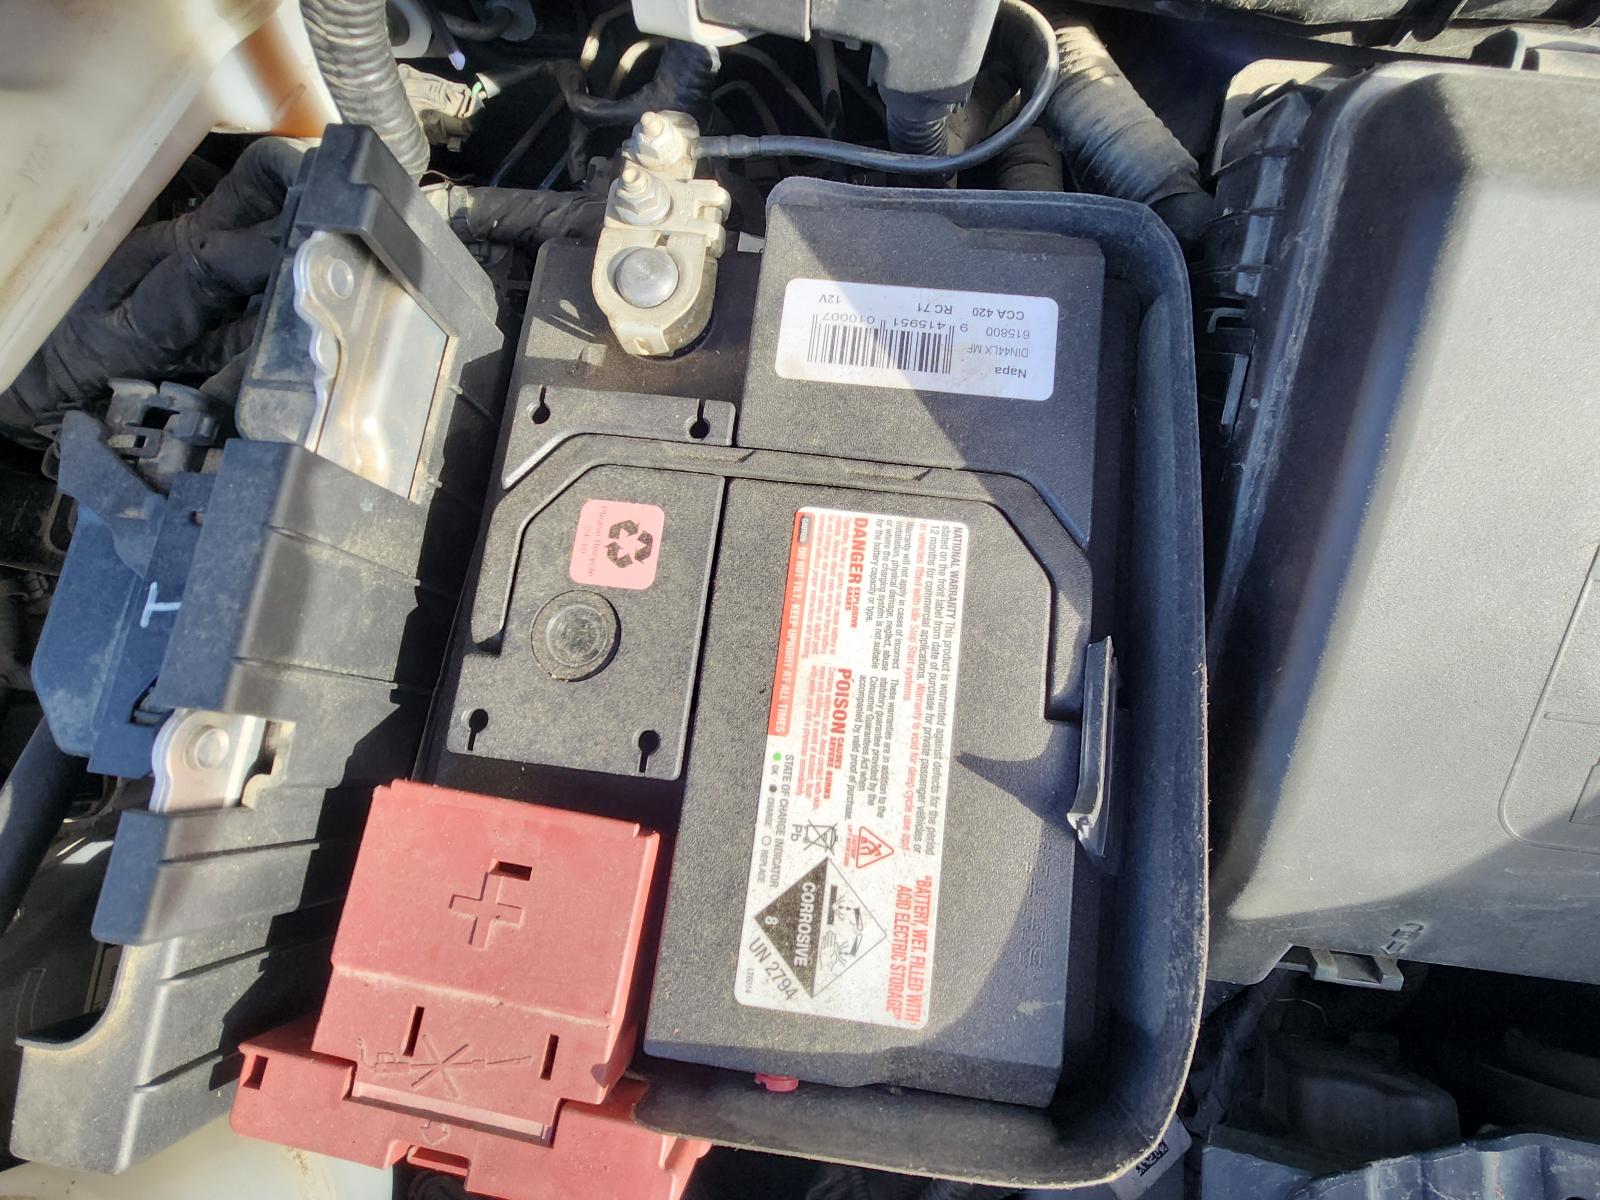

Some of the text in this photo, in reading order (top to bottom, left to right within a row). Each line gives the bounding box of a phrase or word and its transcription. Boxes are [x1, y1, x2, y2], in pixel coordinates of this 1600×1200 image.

[819, 294, 1024, 319] CCA 420 RC 71 12V
[823, 312, 967, 331] 9 415951 010007
[986, 327, 1029, 338] 615800
[967, 344, 1028, 357] DIN44LX MF
[994, 366, 1026, 378] Napa
[874, 529, 882, 540] the
[884, 529, 892, 548] where
[901, 521, 913, 551] Warranty
[930, 525, 938, 534] 12
[797, 547, 806, 559] DO
[848, 517, 867, 583] DANGER
[870, 542, 880, 564] battery
[882, 550, 890, 561] the
[902, 553, 910, 564] will
[927, 537, 937, 565] months
[950, 527, 962, 567] NATIONAL
[795, 561, 804, 576] NOT
[866, 566, 877, 594] capacity
[878, 563, 889, 592] charging
[926, 568, 935, 579] for
[790, 581, 802, 601] TILT,
[897, 579, 907, 597] apply
[946, 570, 958, 618] WARRANTY
[789, 604, 799, 625] KEEP
[850, 587, 860, 627] EXPLOSIVE
[875, 594, 885, 618] system
[921, 580, 934, 627] commercial
[944, 622, 954, 638] This
[783, 629, 796, 667] UPRIGHT
[871, 641, 881, 668] suitable
[892, 638, 901, 668] incorrect
[916, 629, 929, 680] applications.
[940, 640, 952, 671] product
[782, 671, 791, 680] AT
[780, 685, 789, 699] ALL
[831, 668, 851, 733] POISON
[912, 683, 924, 719] Warranty
[913, 526, 950, 853] stated on the front label from date of purchase for private passenger vehicles or
[936, 683, 948, 725] warranted
[775, 703, 787, 732] TIMES
[858, 676, 877, 791] Consumer Guarantees Act when
[910, 733, 919, 749] void
[932, 728, 944, 759] against
[823, 736, 835, 798] SEVERE BURNS
[909, 752, 917, 763] for
[905, 766, 916, 787] deep
[931, 762, 942, 793] defects
[902, 790, 914, 811] cycle
[929, 796, 939, 807] for
[770, 754, 792, 887] STATE OF CHARGE INDICATOR
[903, 815, 911, 830] use
[928, 810, 937, 824] the
[791, 824, 801, 841] Pb
[924, 827, 936, 855] period
[896, 885, 912, 909] ACID
[765, 916, 777, 925] 8
[793, 881, 815, 966] CORROSIVE
[891, 912, 908, 961] ELECTRIC
[749, 937, 797, 1000] UN 2794
[908, 956, 924, 991] FILLED
[904, 993, 921, 1021] WITH
